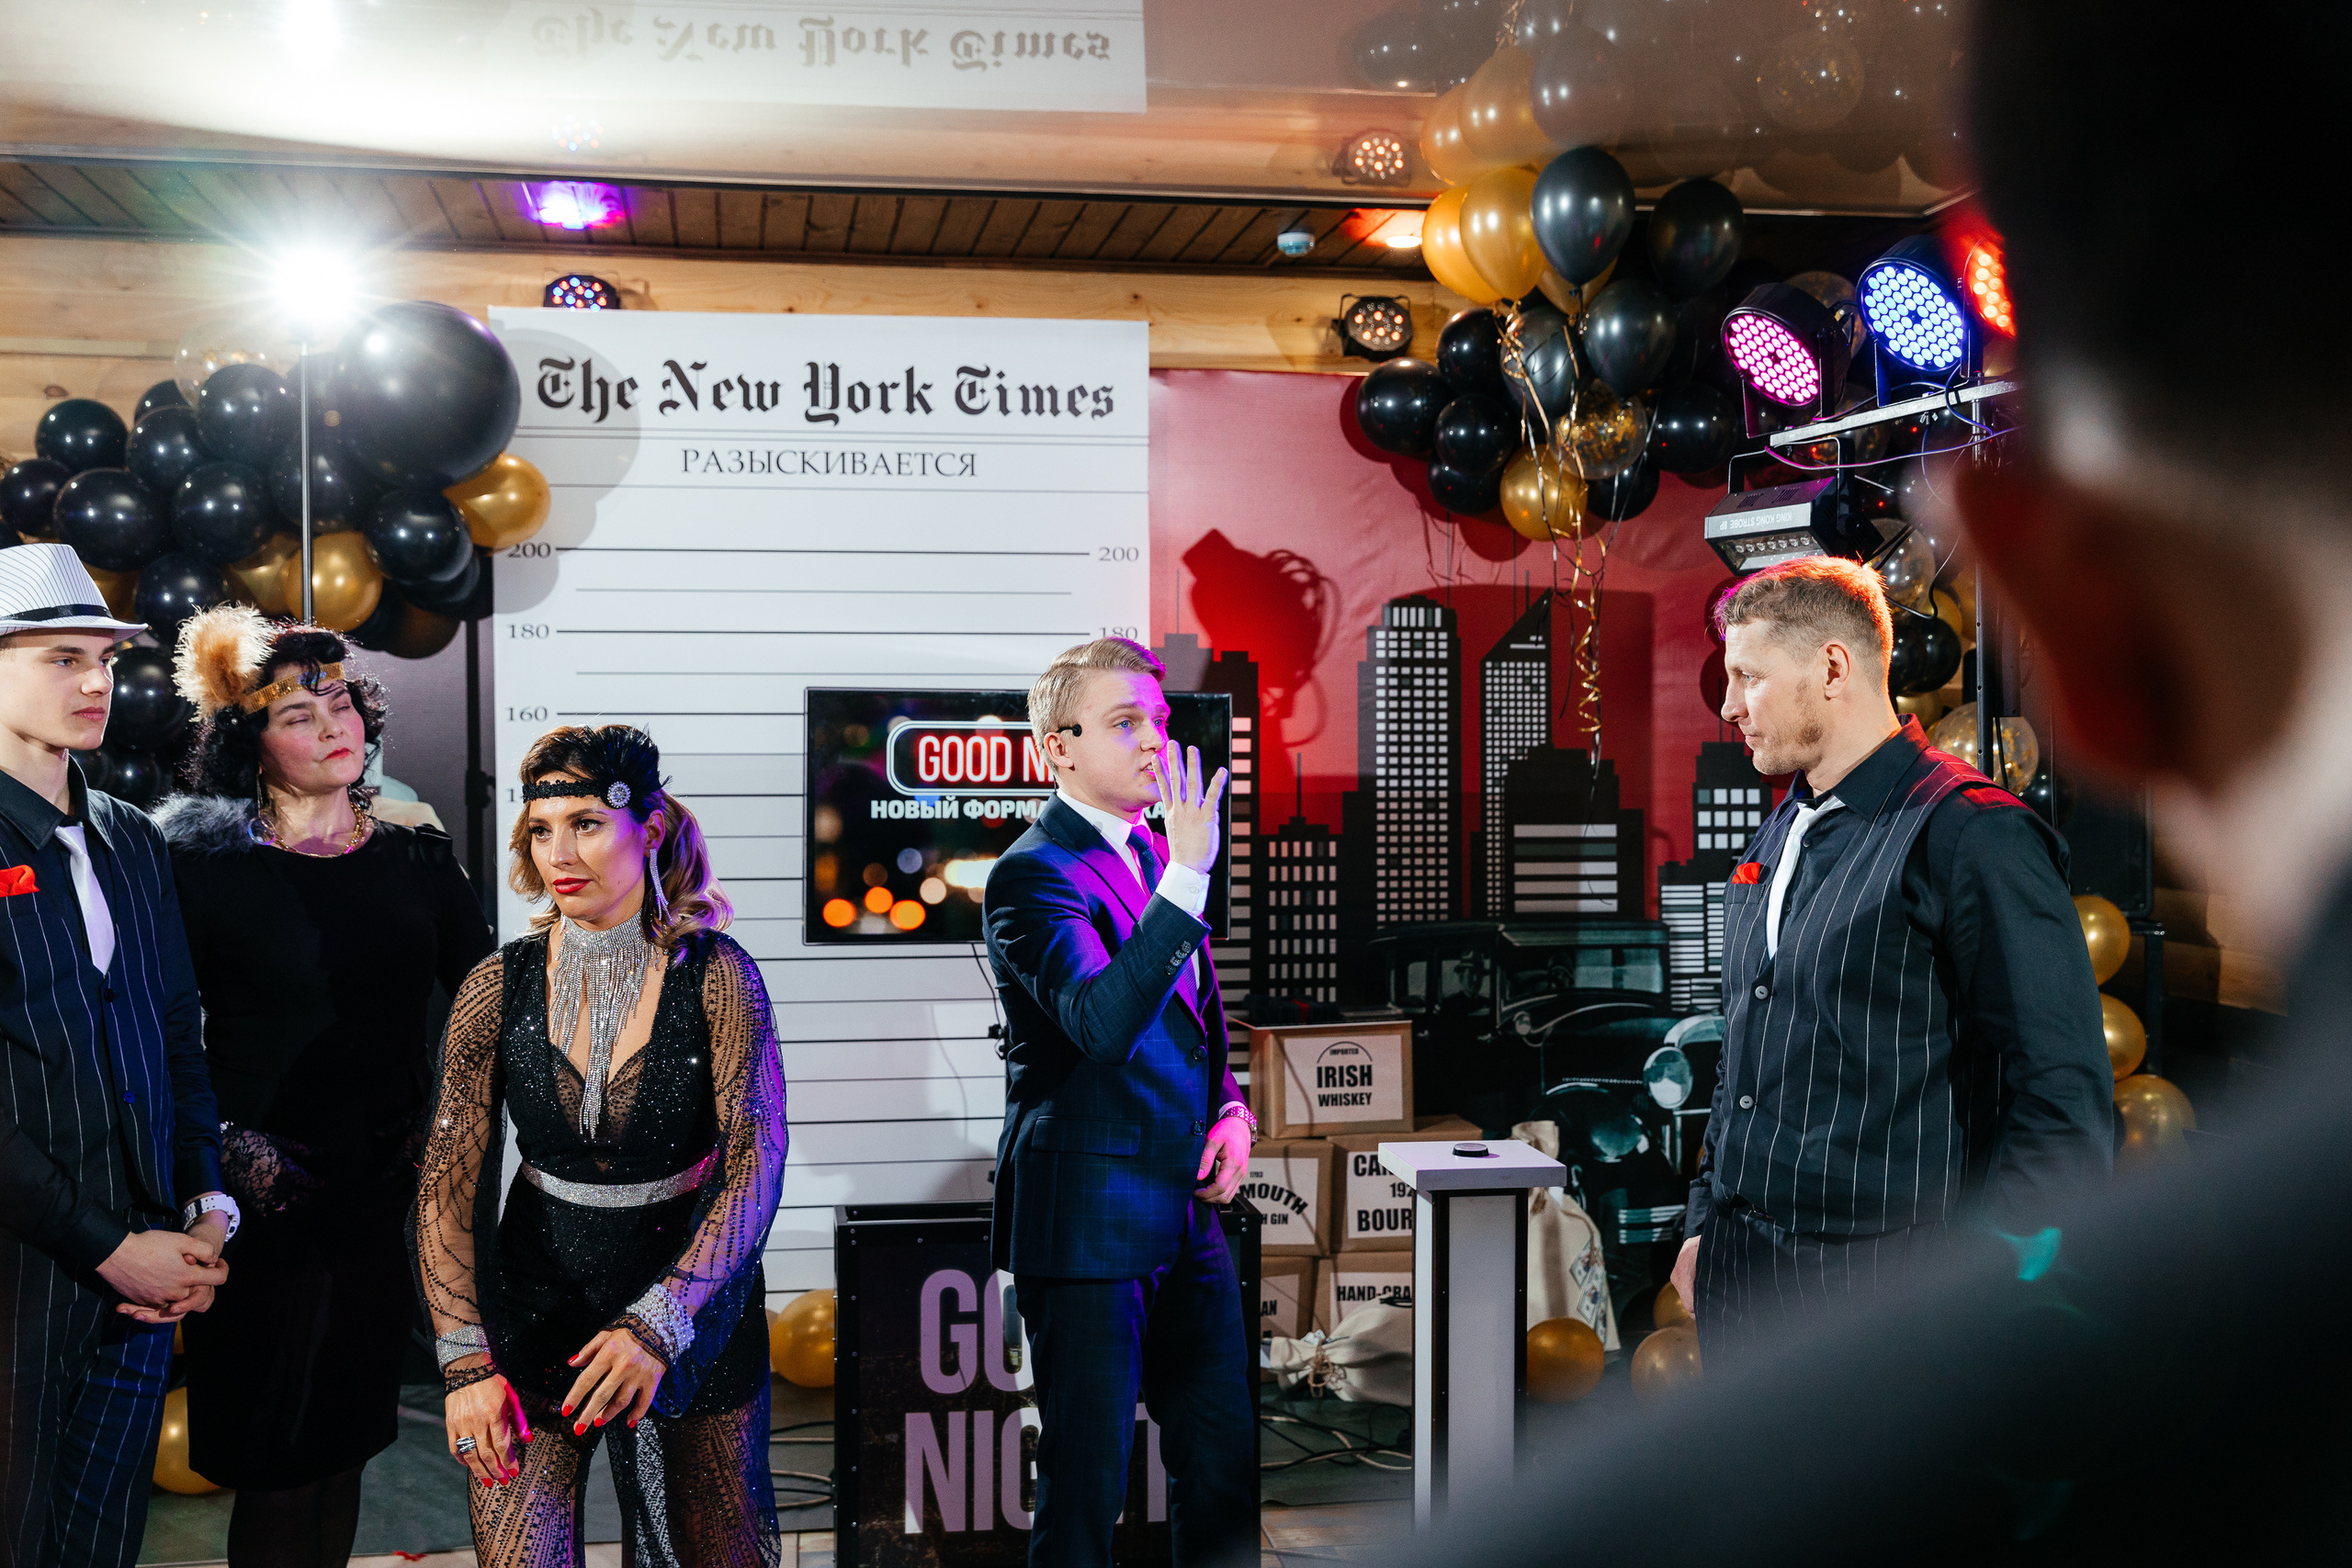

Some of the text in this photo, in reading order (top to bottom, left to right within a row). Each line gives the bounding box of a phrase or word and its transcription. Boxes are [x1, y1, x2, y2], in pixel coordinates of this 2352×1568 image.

[537, 356, 1114, 427] The New York Times
[681, 447, 978, 477] РАЗЫСКИВАЕТСЯ
[1730, 516, 1755, 529] STROBE
[1756, 514, 1775, 526] KONG
[1776, 512, 1792, 523] KING
[508, 542, 551, 558] 200
[1099, 547, 1139, 562] 200
[507, 623, 549, 639] 180
[505, 705, 548, 722] 160
[919, 736, 1012, 782] GOOD
[871, 795, 959, 819] НОВЫЙ
[1317, 1065, 1373, 1089] IRISH
[1317, 1092, 1372, 1107] WHISKEY
[1271, 1213, 1288, 1224] GIN
[1261, 1300, 1277, 1316] AN
